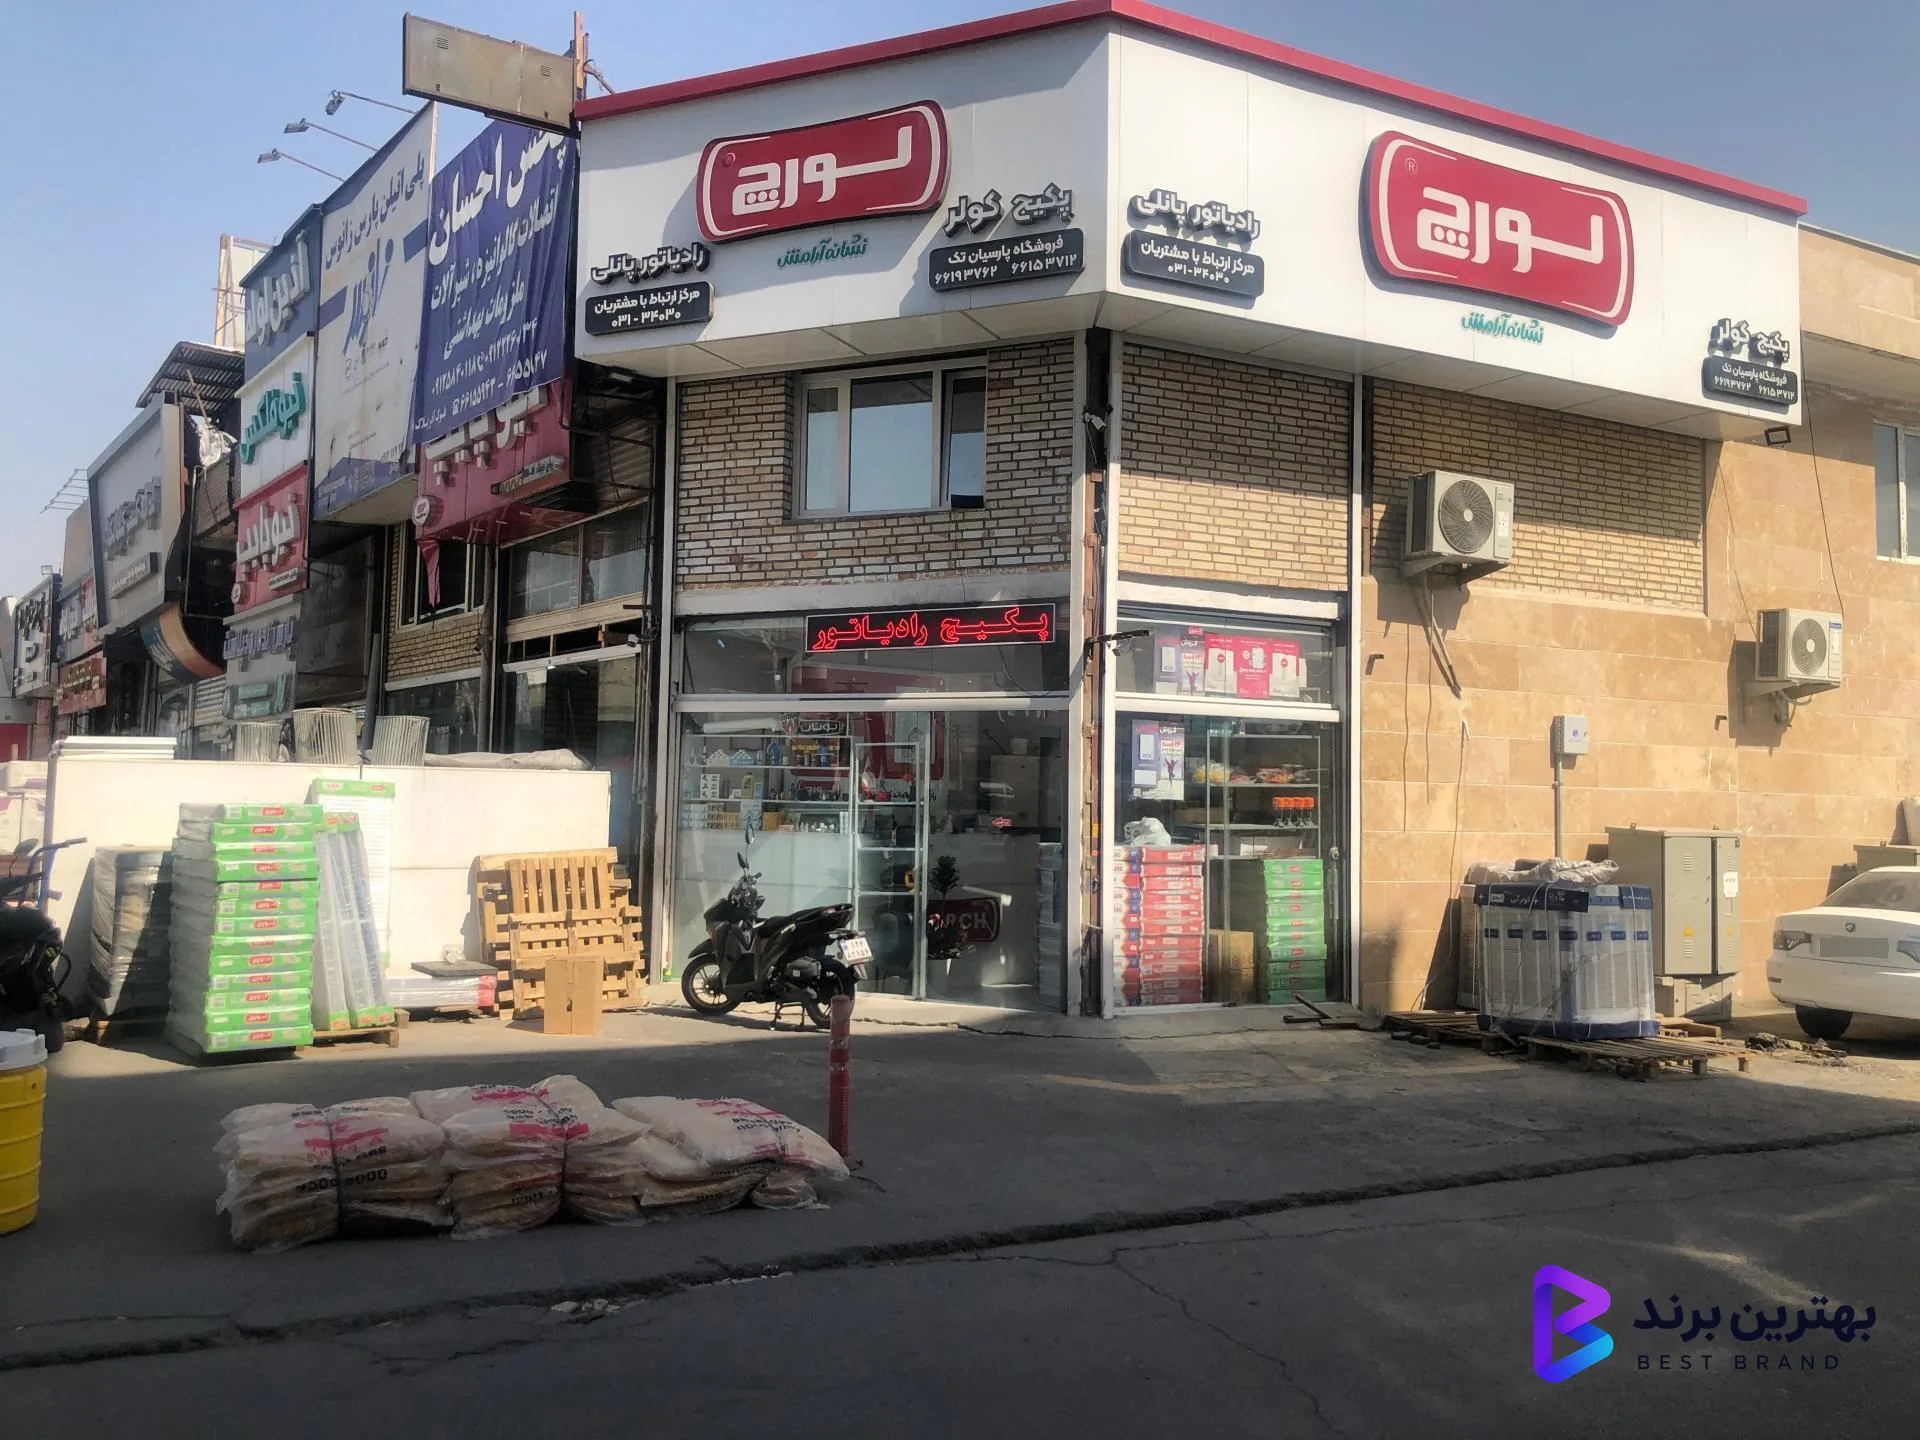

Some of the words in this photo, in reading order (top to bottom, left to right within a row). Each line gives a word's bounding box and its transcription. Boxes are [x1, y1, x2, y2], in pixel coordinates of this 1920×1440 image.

[405, 150, 424, 201] پلی
[732, 126, 912, 215] لورچ
[429, 133, 502, 265] احسان
[1012, 183, 1074, 222] پکیج
[1135, 190, 1187, 225] پانلی
[354, 192, 379, 246] پارس
[518, 184, 559, 247] اتصالات
[943, 189, 1002, 236] کولر
[1188, 201, 1260, 239] رادیاتور
[1417, 186, 1603, 273] لورچ
[948, 250, 966, 264] تک
[967, 244, 1010, 264] پارسیان
[1013, 234, 1064, 256] فروشگاه
[1141, 240, 1189, 259] مشتریان
[1192, 248, 1200, 264] با
[592, 253, 638, 282] پانلی
[640, 242, 709, 279] رادیاتور
[1011, 254, 1077, 274] ۶۶۱۵۳۷۱۲
[1202, 251, 1231, 271] ارتباط
[1231, 259, 1255, 275] مرکز
[935, 265, 998, 284] ۶۶۱۹۳۷۶۲
[594, 296, 638, 314] مشتریان
[640, 295, 648, 308] با
[649, 290, 677, 306] ارتباط
[678, 288, 700, 302] مرکز
[1716, 318, 1750, 348] کولر
[1755, 331, 1789, 361] پکیج
[1722, 362, 1732, 373] تک
[1732, 366, 1758, 383] پارسیان
[1758, 370, 1788, 386] فروشگاه
[812, 612, 928, 650] رادیاتور
[940, 608, 1048, 643] پکیج
